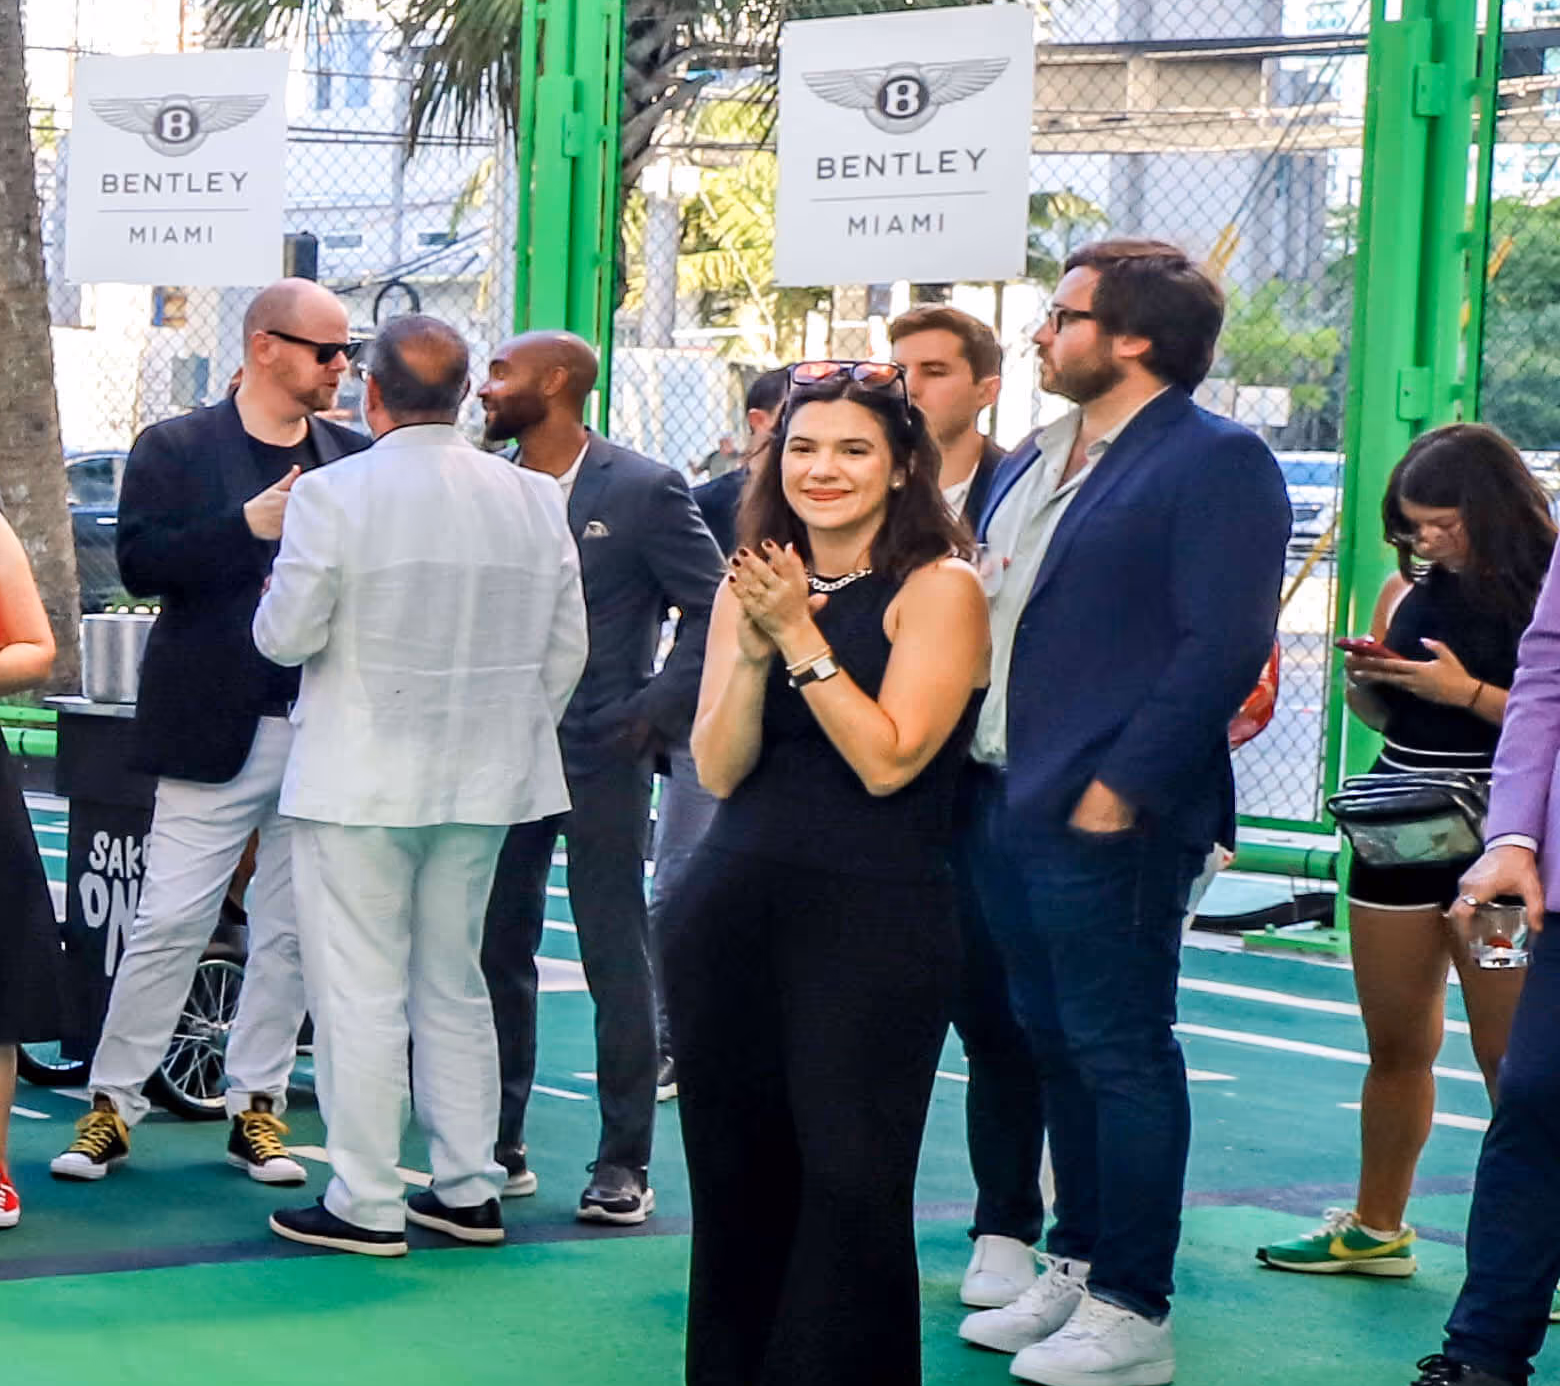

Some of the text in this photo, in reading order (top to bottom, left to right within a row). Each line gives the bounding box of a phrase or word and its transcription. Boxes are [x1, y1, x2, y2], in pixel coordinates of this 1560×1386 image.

[816, 148, 987, 181] BENTLEY
[101, 170, 249, 195] BENTLEY
[128, 225, 214, 245] MIAMI
[847, 213, 946, 237] MIAMI
